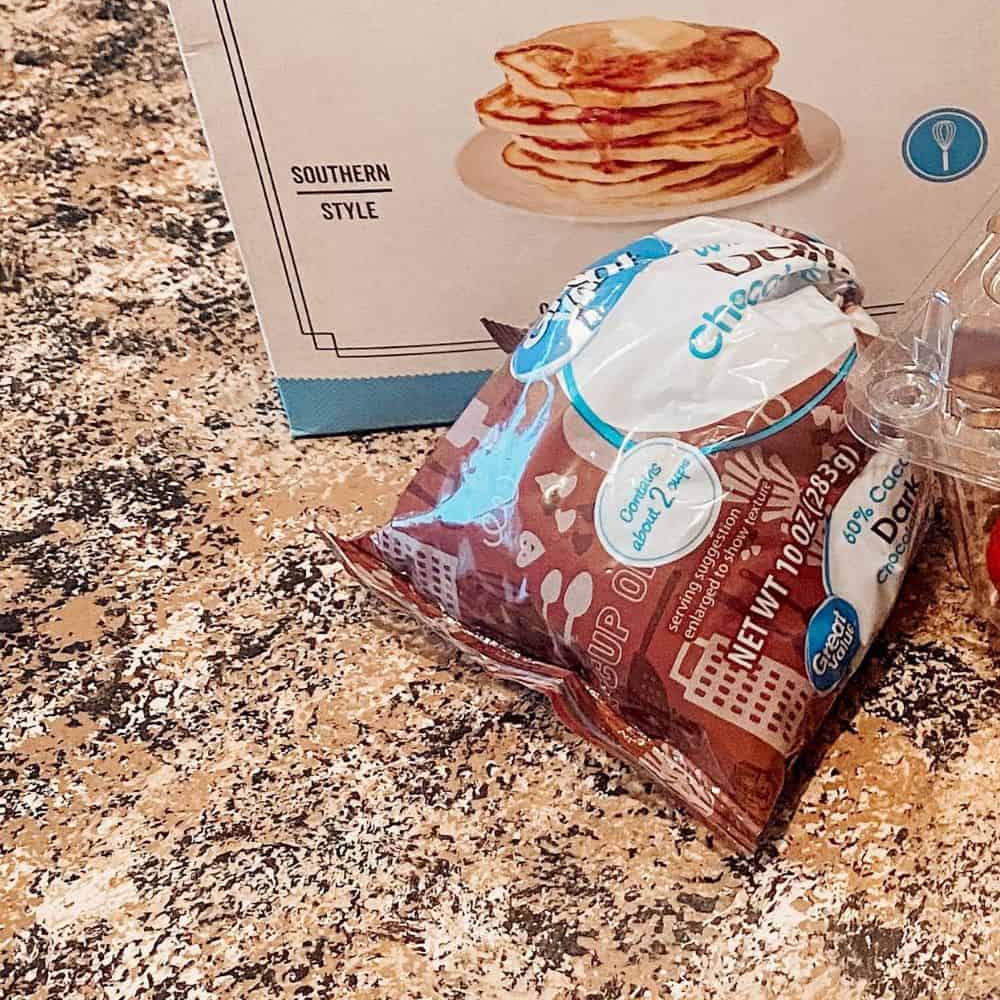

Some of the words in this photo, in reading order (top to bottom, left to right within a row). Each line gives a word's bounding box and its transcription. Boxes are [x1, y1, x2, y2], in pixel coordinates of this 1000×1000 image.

[291, 163, 391, 184] SOUTHERN
[320, 201, 380, 221] STYLE
[620, 462, 662, 524] Contains
[803, 444, 862, 518] (283g)
[871, 474, 921, 545] Dark
[631, 507, 661, 552] about
[649, 487, 676, 509] 2
[790, 507, 818, 548] OZ
[843, 505, 874, 546] 60%
[668, 582, 703, 633] serving
[695, 507, 742, 580] suggestion
[684, 581, 721, 640] enlarged
[714, 562, 729, 580] to
[727, 527, 751, 564] show
[744, 479, 772, 526] texture
[775, 543, 804, 577] 10
[750, 574, 788, 620] WT
[727, 615, 769, 670] NET
[811, 609, 846, 676] Great
